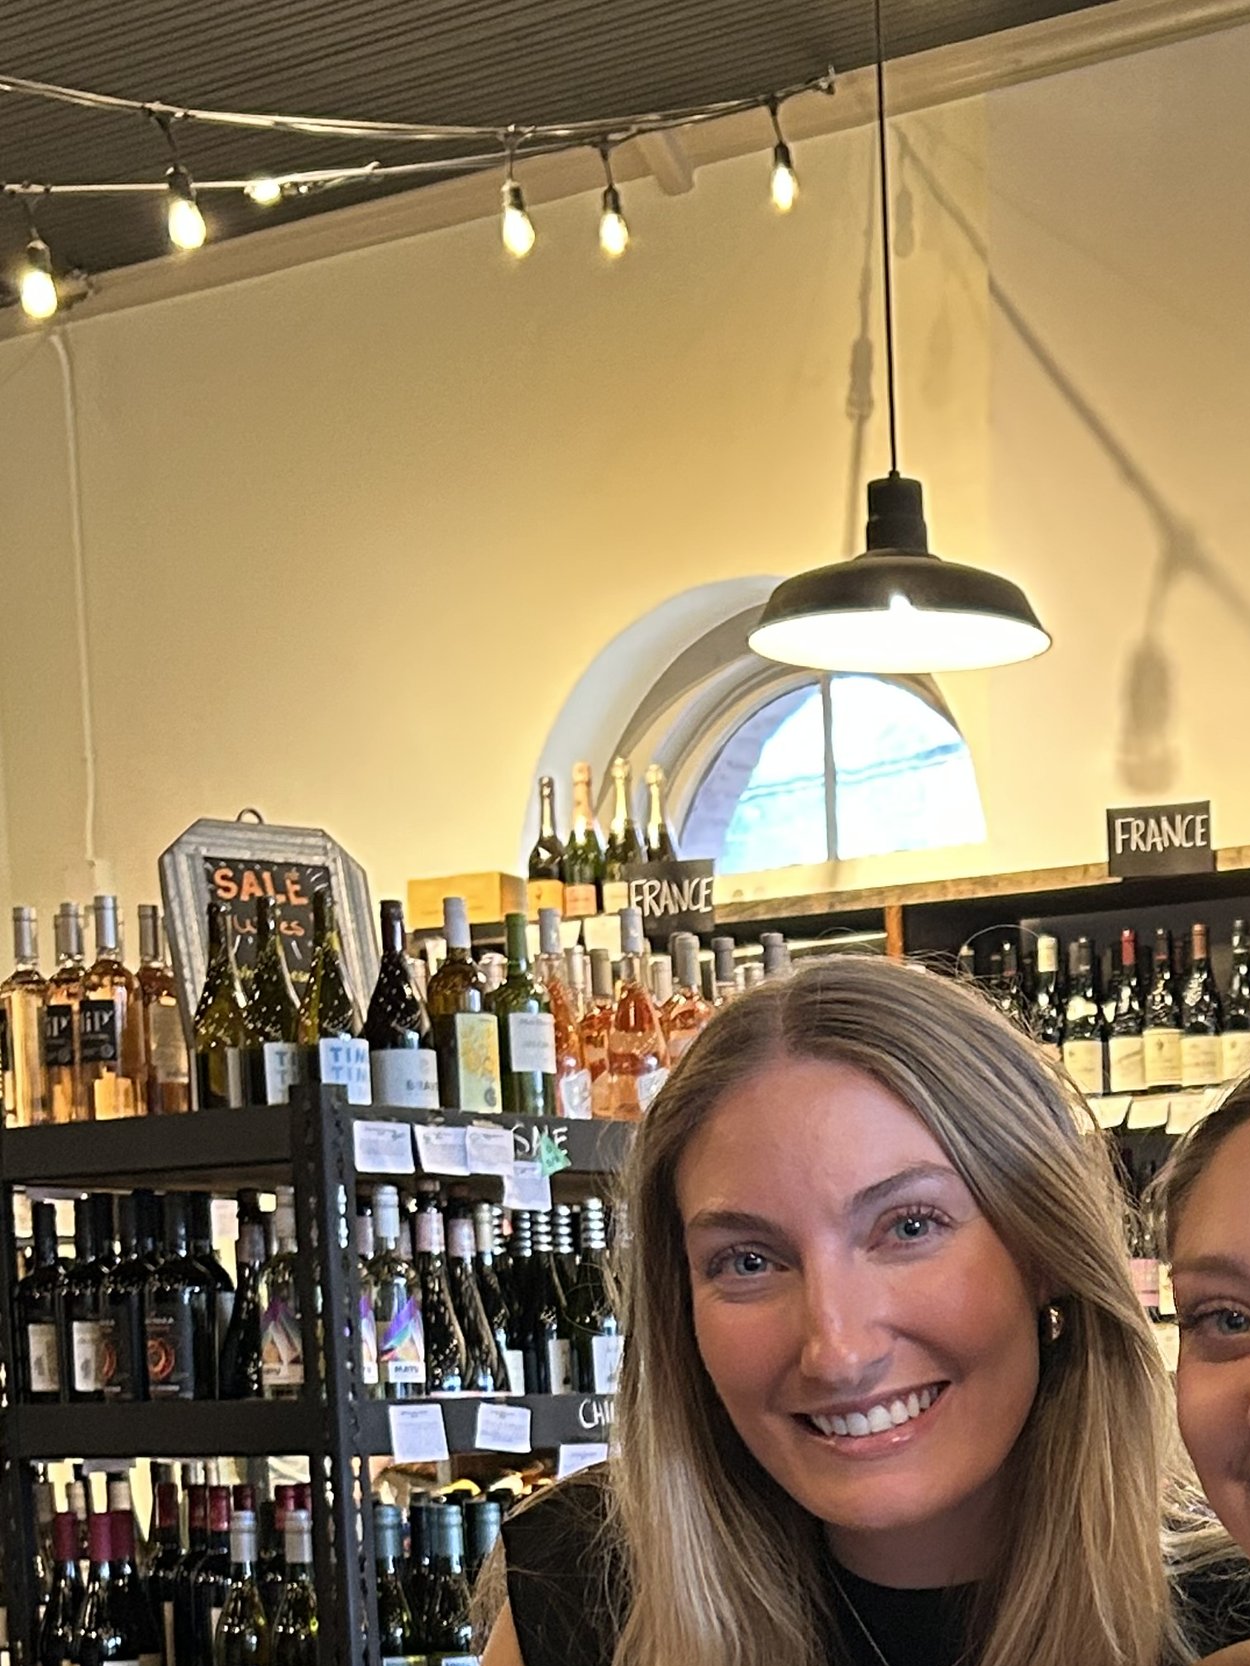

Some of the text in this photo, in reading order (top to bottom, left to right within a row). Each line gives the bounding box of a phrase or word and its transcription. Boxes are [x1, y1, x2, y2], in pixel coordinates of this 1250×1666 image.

[1114, 813, 1209, 855] FRANCE
[213, 867, 310, 906] SALE
[630, 877, 714, 917] FRANCE
